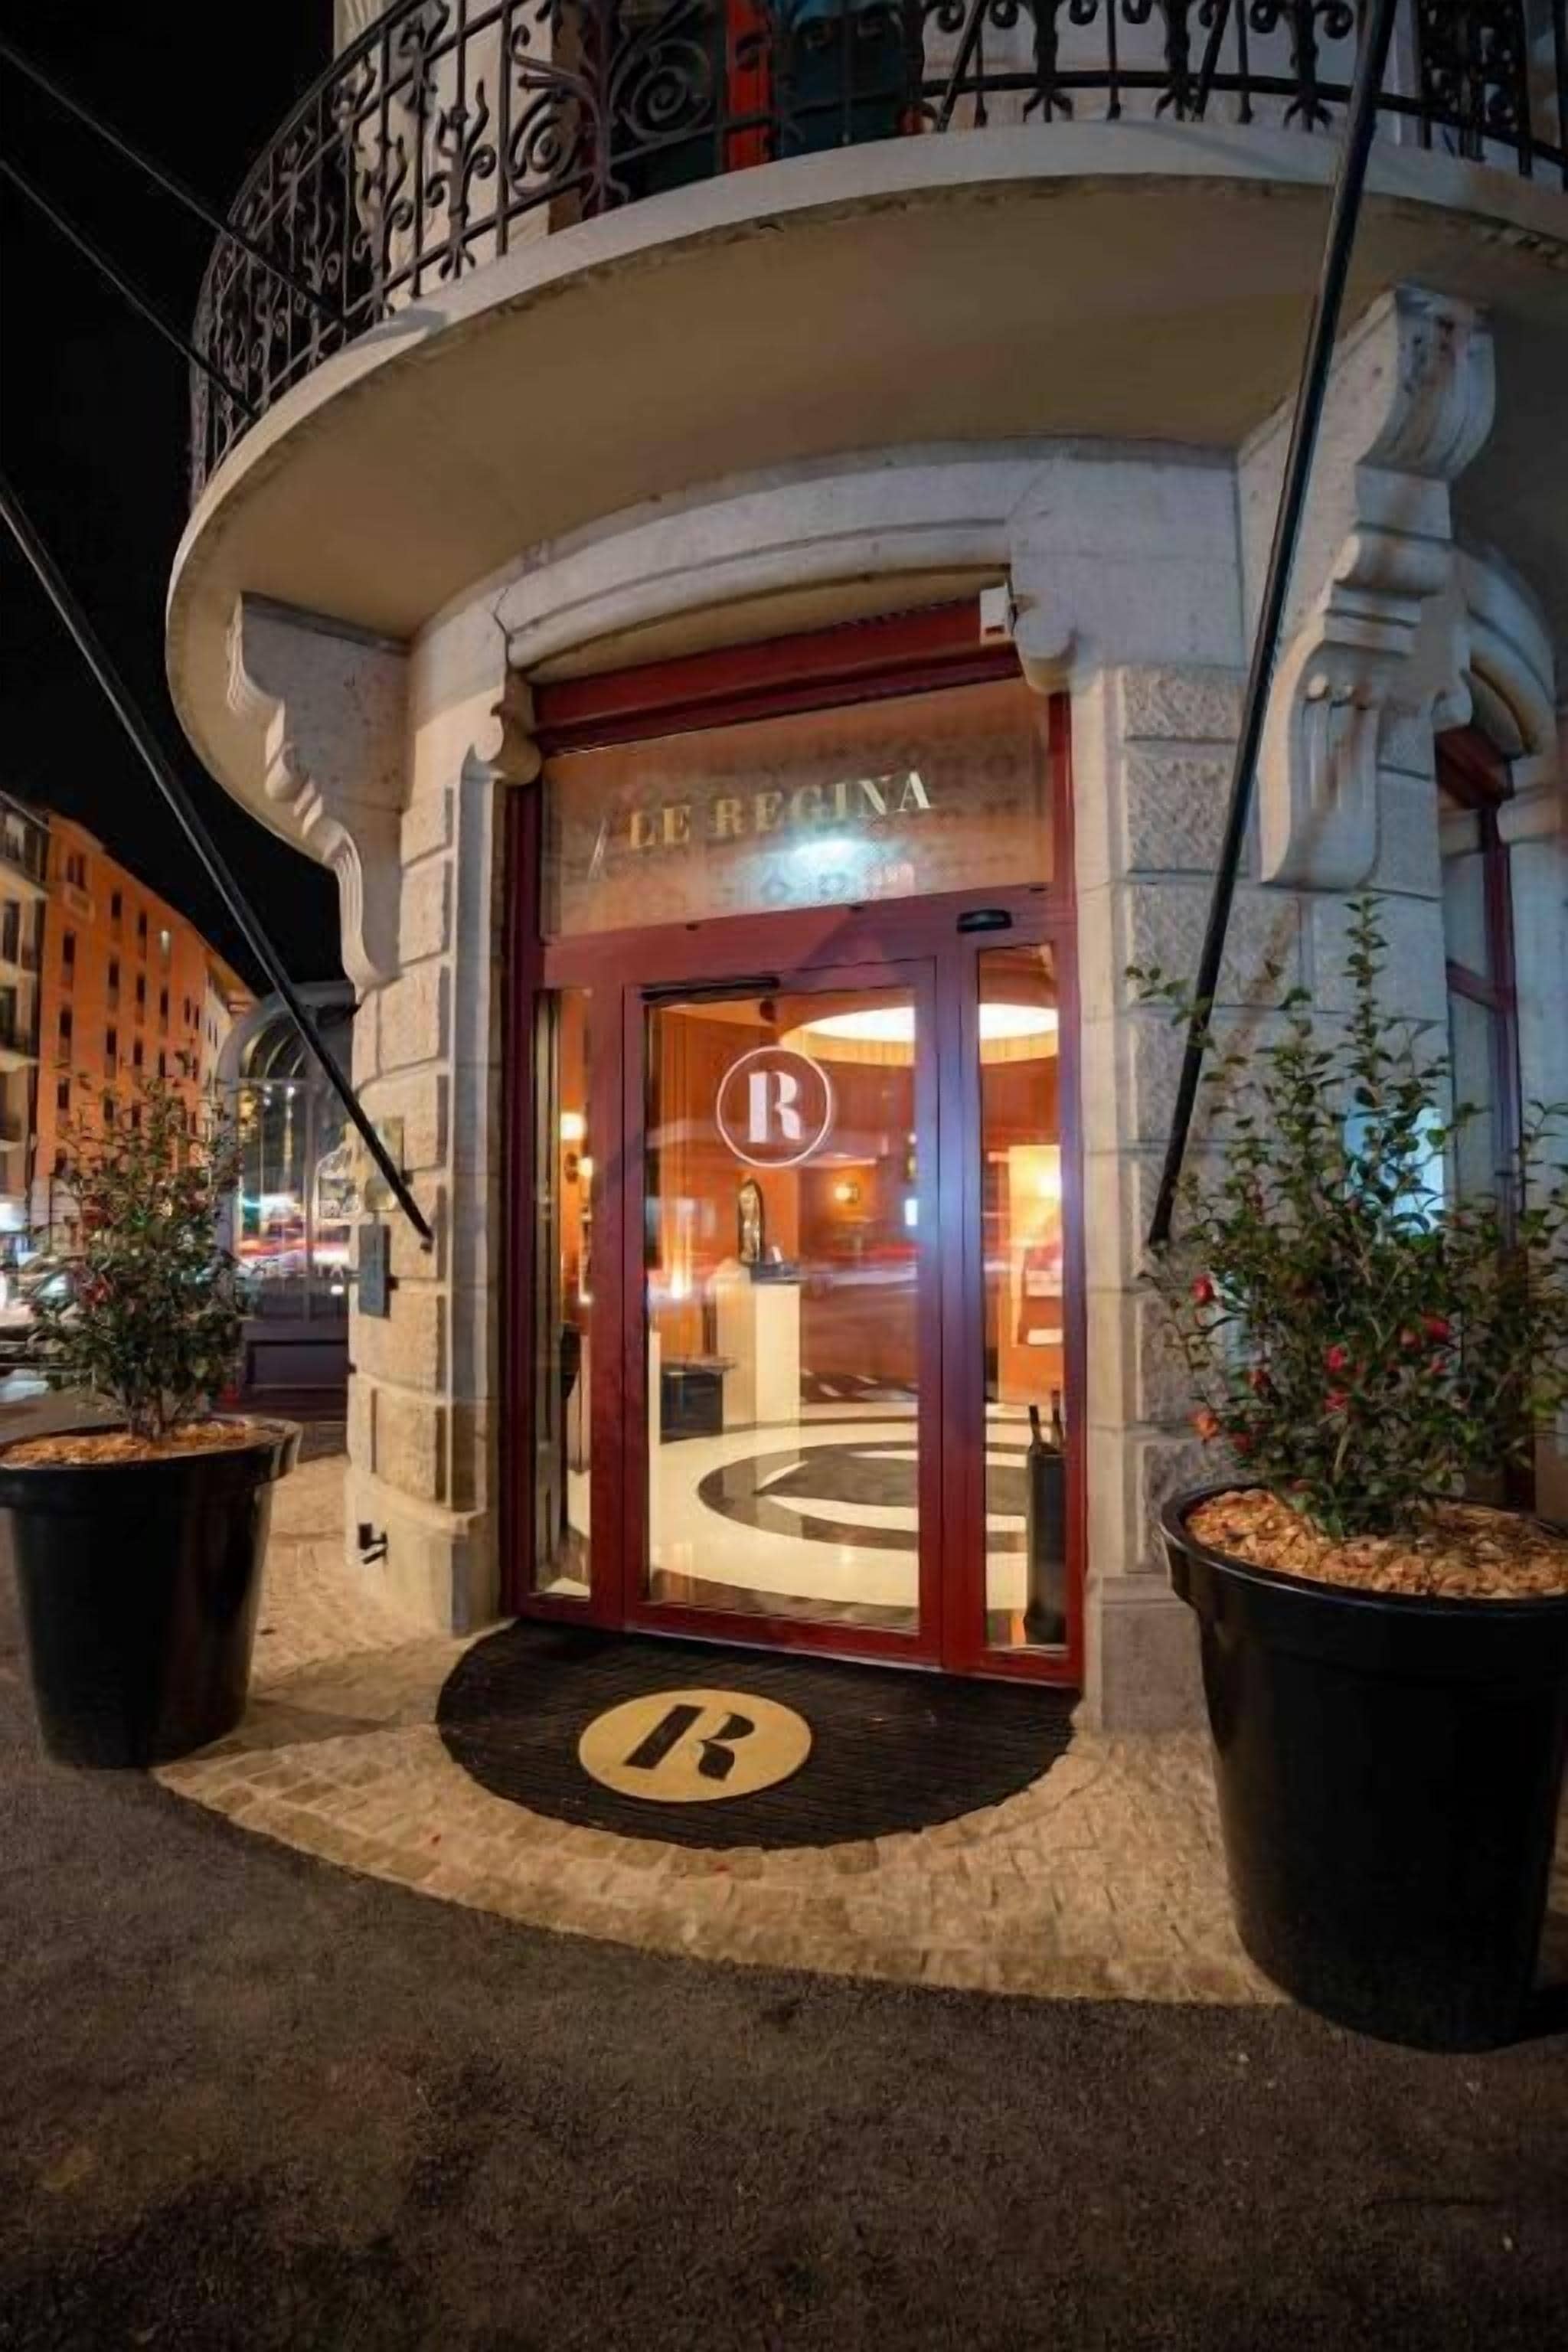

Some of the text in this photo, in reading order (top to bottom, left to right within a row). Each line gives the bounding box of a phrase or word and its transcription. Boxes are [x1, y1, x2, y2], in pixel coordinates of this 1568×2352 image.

[629, 771, 932, 848] LE REGINA
[748, 1071, 802, 1144] R
[623, 1704, 755, 1782] R
